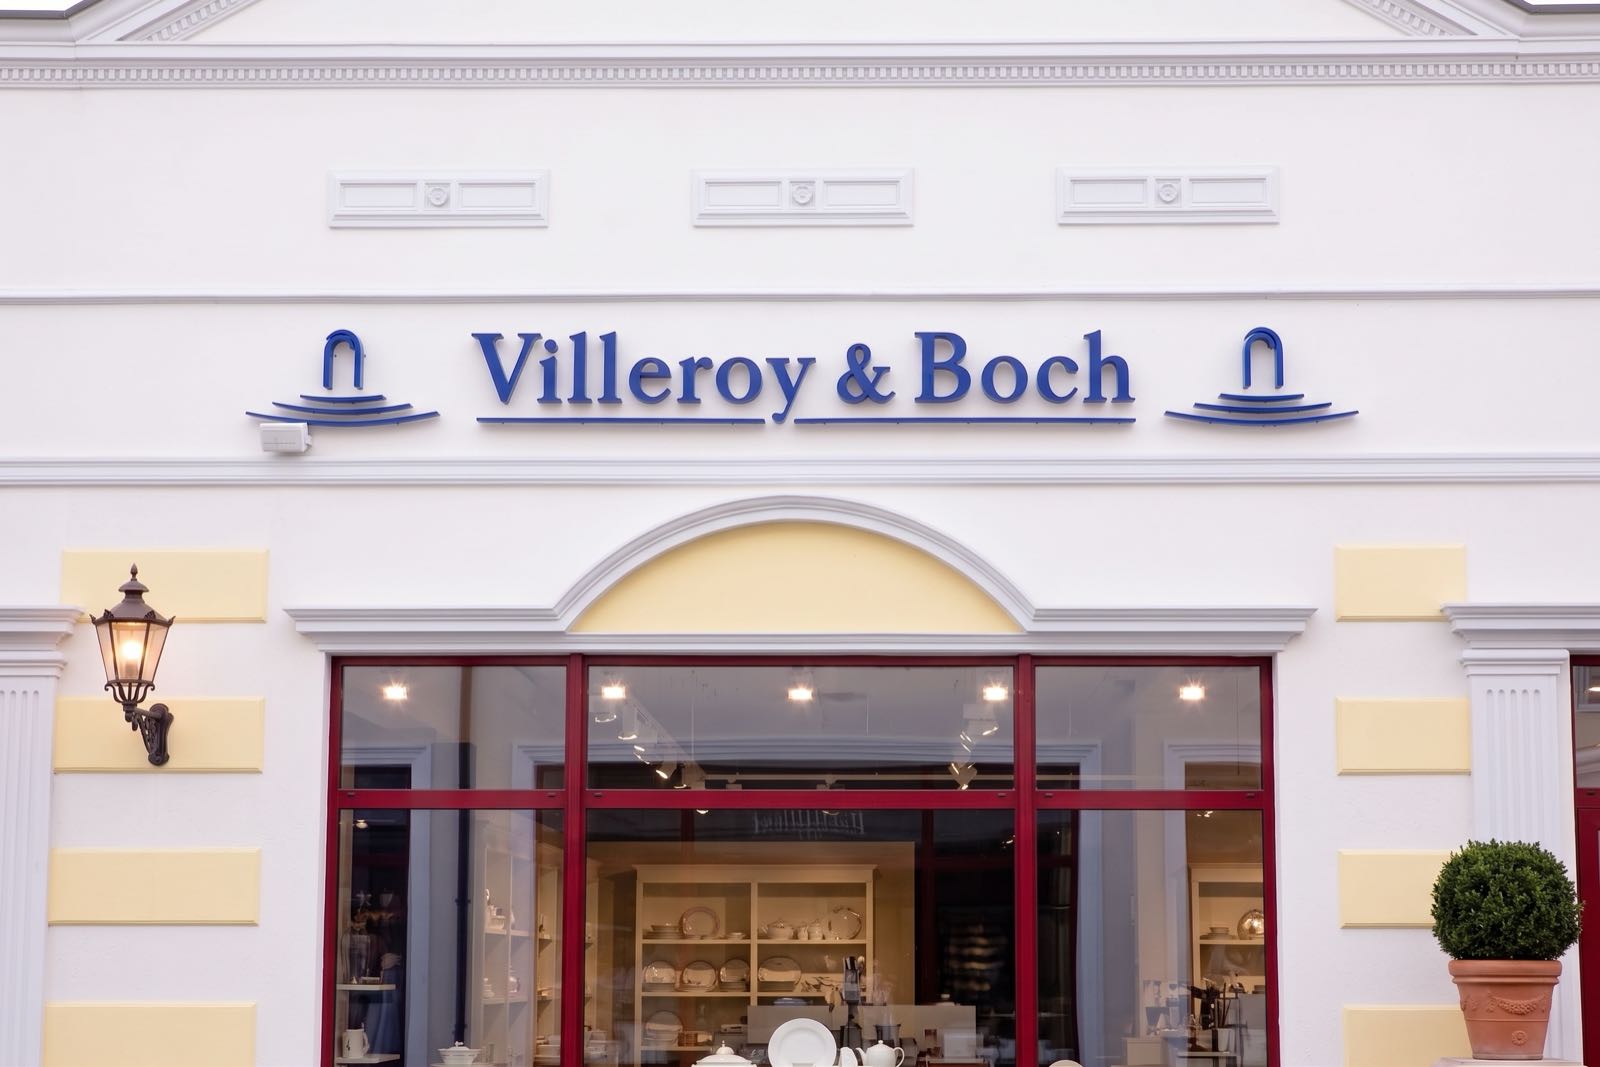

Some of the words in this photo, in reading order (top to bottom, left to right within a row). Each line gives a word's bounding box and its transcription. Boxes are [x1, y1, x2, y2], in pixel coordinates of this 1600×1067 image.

[471, 331, 817, 424] Villeroy
[836, 343, 896, 405] &
[914, 330, 1136, 404] Boch
